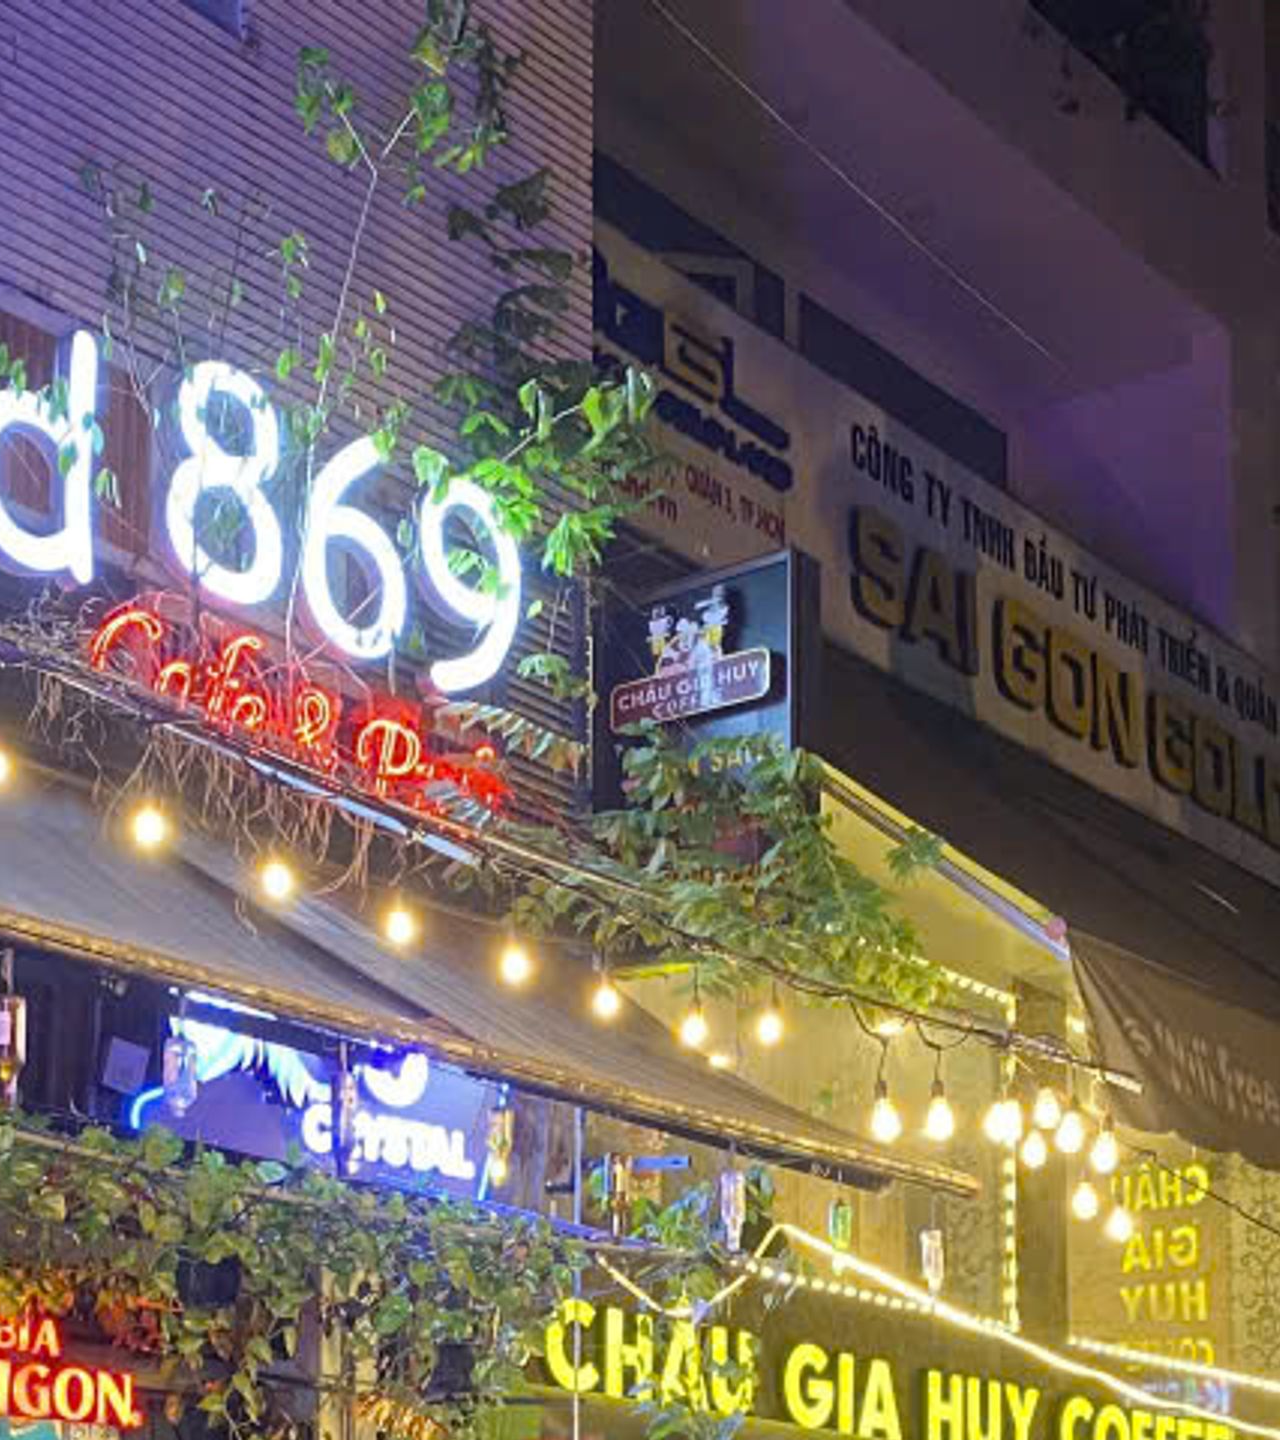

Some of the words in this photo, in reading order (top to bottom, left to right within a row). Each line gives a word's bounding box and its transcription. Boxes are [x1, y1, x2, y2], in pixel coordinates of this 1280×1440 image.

[166, 360, 521, 693] 869
[851, 423, 914, 504] CÔNG
[923, 469, 952, 528] TY
[960, 495, 1016, 572] TNHH
[1217, 664, 1230, 704] &
[721, 657, 760, 686] HUY
